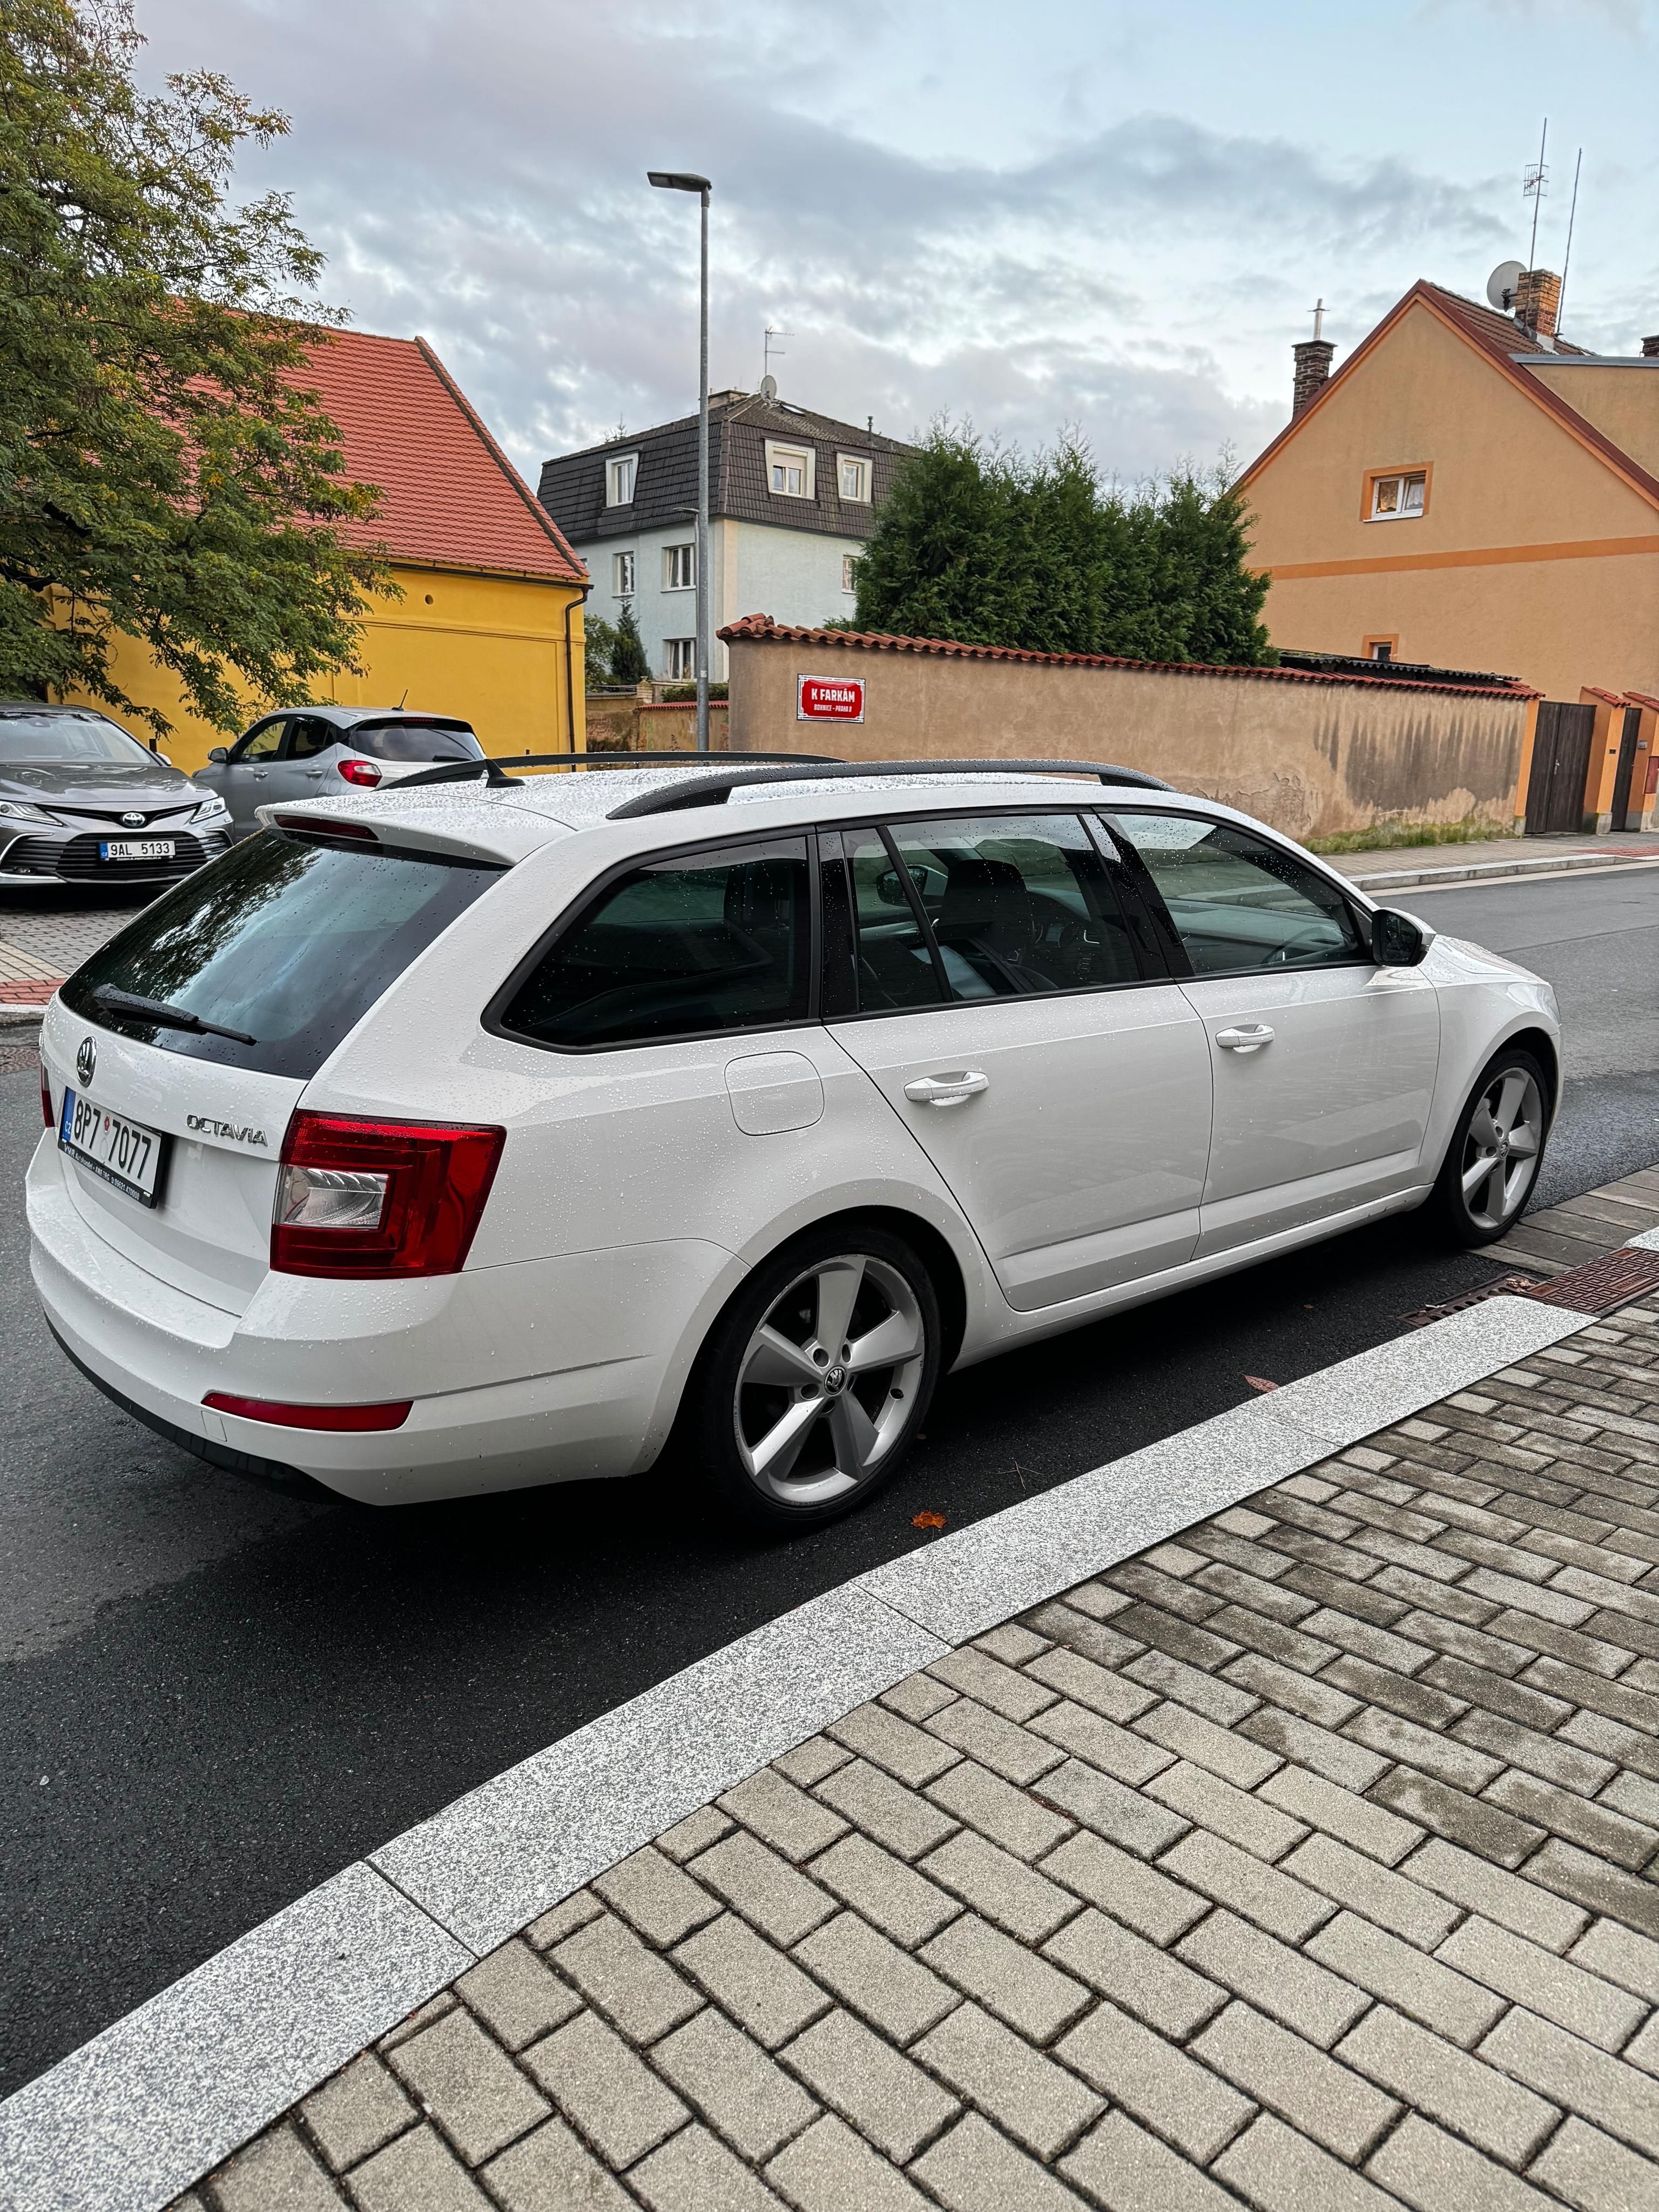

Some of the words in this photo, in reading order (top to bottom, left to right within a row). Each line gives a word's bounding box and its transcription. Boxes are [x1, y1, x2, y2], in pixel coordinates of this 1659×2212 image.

[811, 688, 818, 700] K
[820, 688, 855, 703] FARKÁM
[111, 844, 132, 855] 9AL
[141, 842, 170, 854] 5133
[65, 1121, 71, 1134] CZ
[187, 1114, 268, 1147] OCTAVIA
[74, 1100, 101, 1149] 8P7
[108, 1118, 151, 1180] 7077
